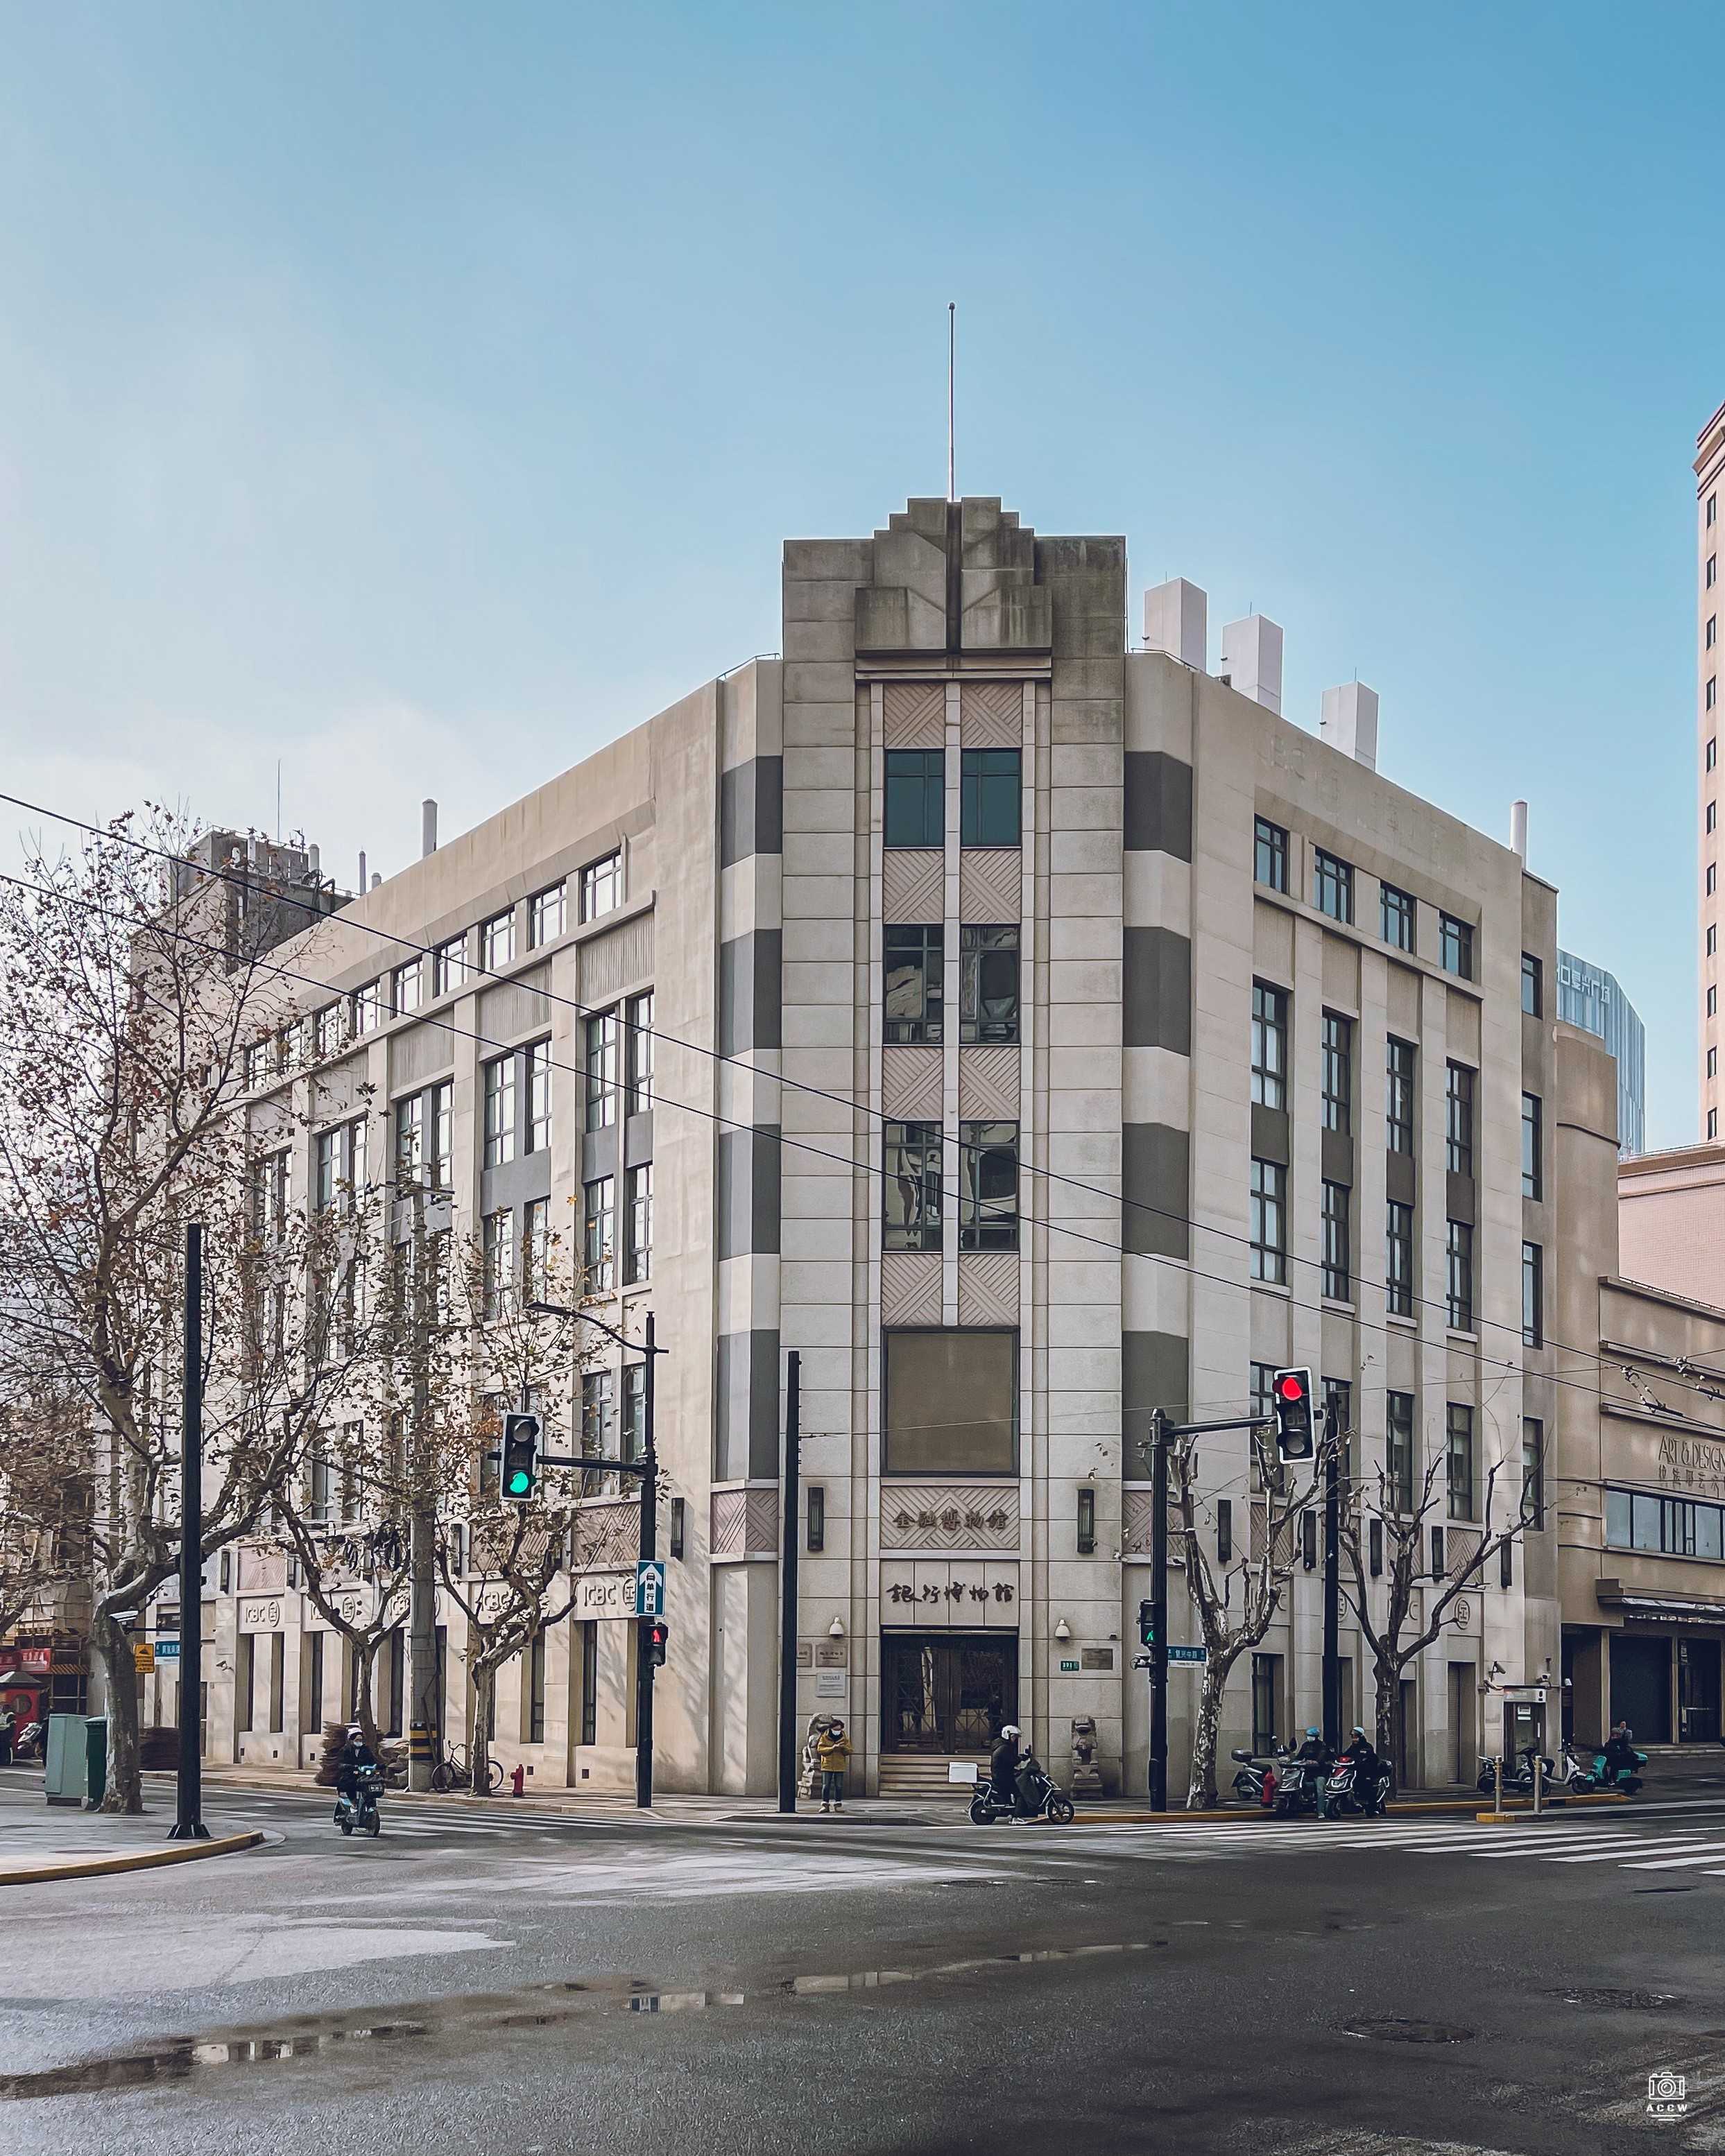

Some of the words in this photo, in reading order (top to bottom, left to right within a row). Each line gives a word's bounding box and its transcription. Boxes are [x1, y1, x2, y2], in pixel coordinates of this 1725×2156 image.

[1658, 1435, 1679, 1464] ART
[584, 1585, 617, 1607] ICBC
[246, 1607, 265, 1623] ICBC
